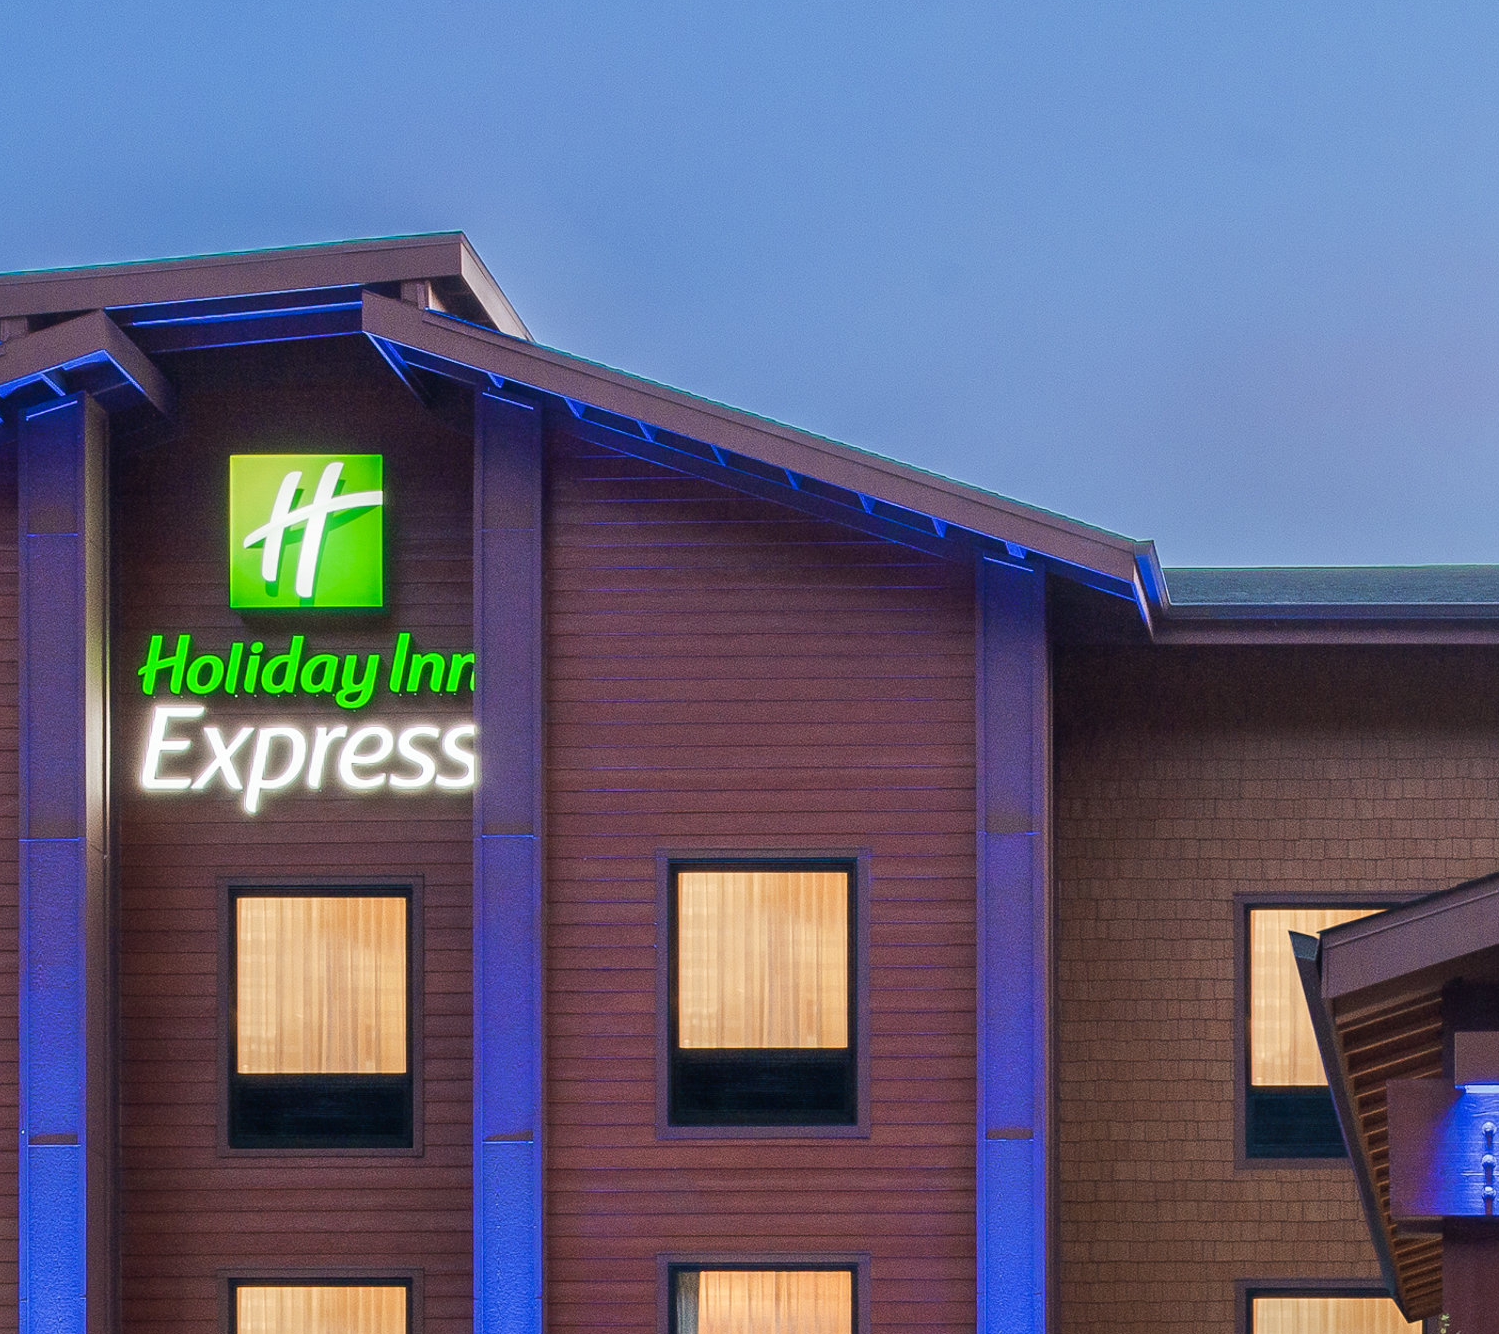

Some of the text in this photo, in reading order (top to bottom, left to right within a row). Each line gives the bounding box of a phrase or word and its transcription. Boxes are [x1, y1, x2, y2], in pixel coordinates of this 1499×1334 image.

[243, 462, 383, 598] H
[138, 632, 475, 709] Holiday Inn
[140, 704, 476, 813] Express
